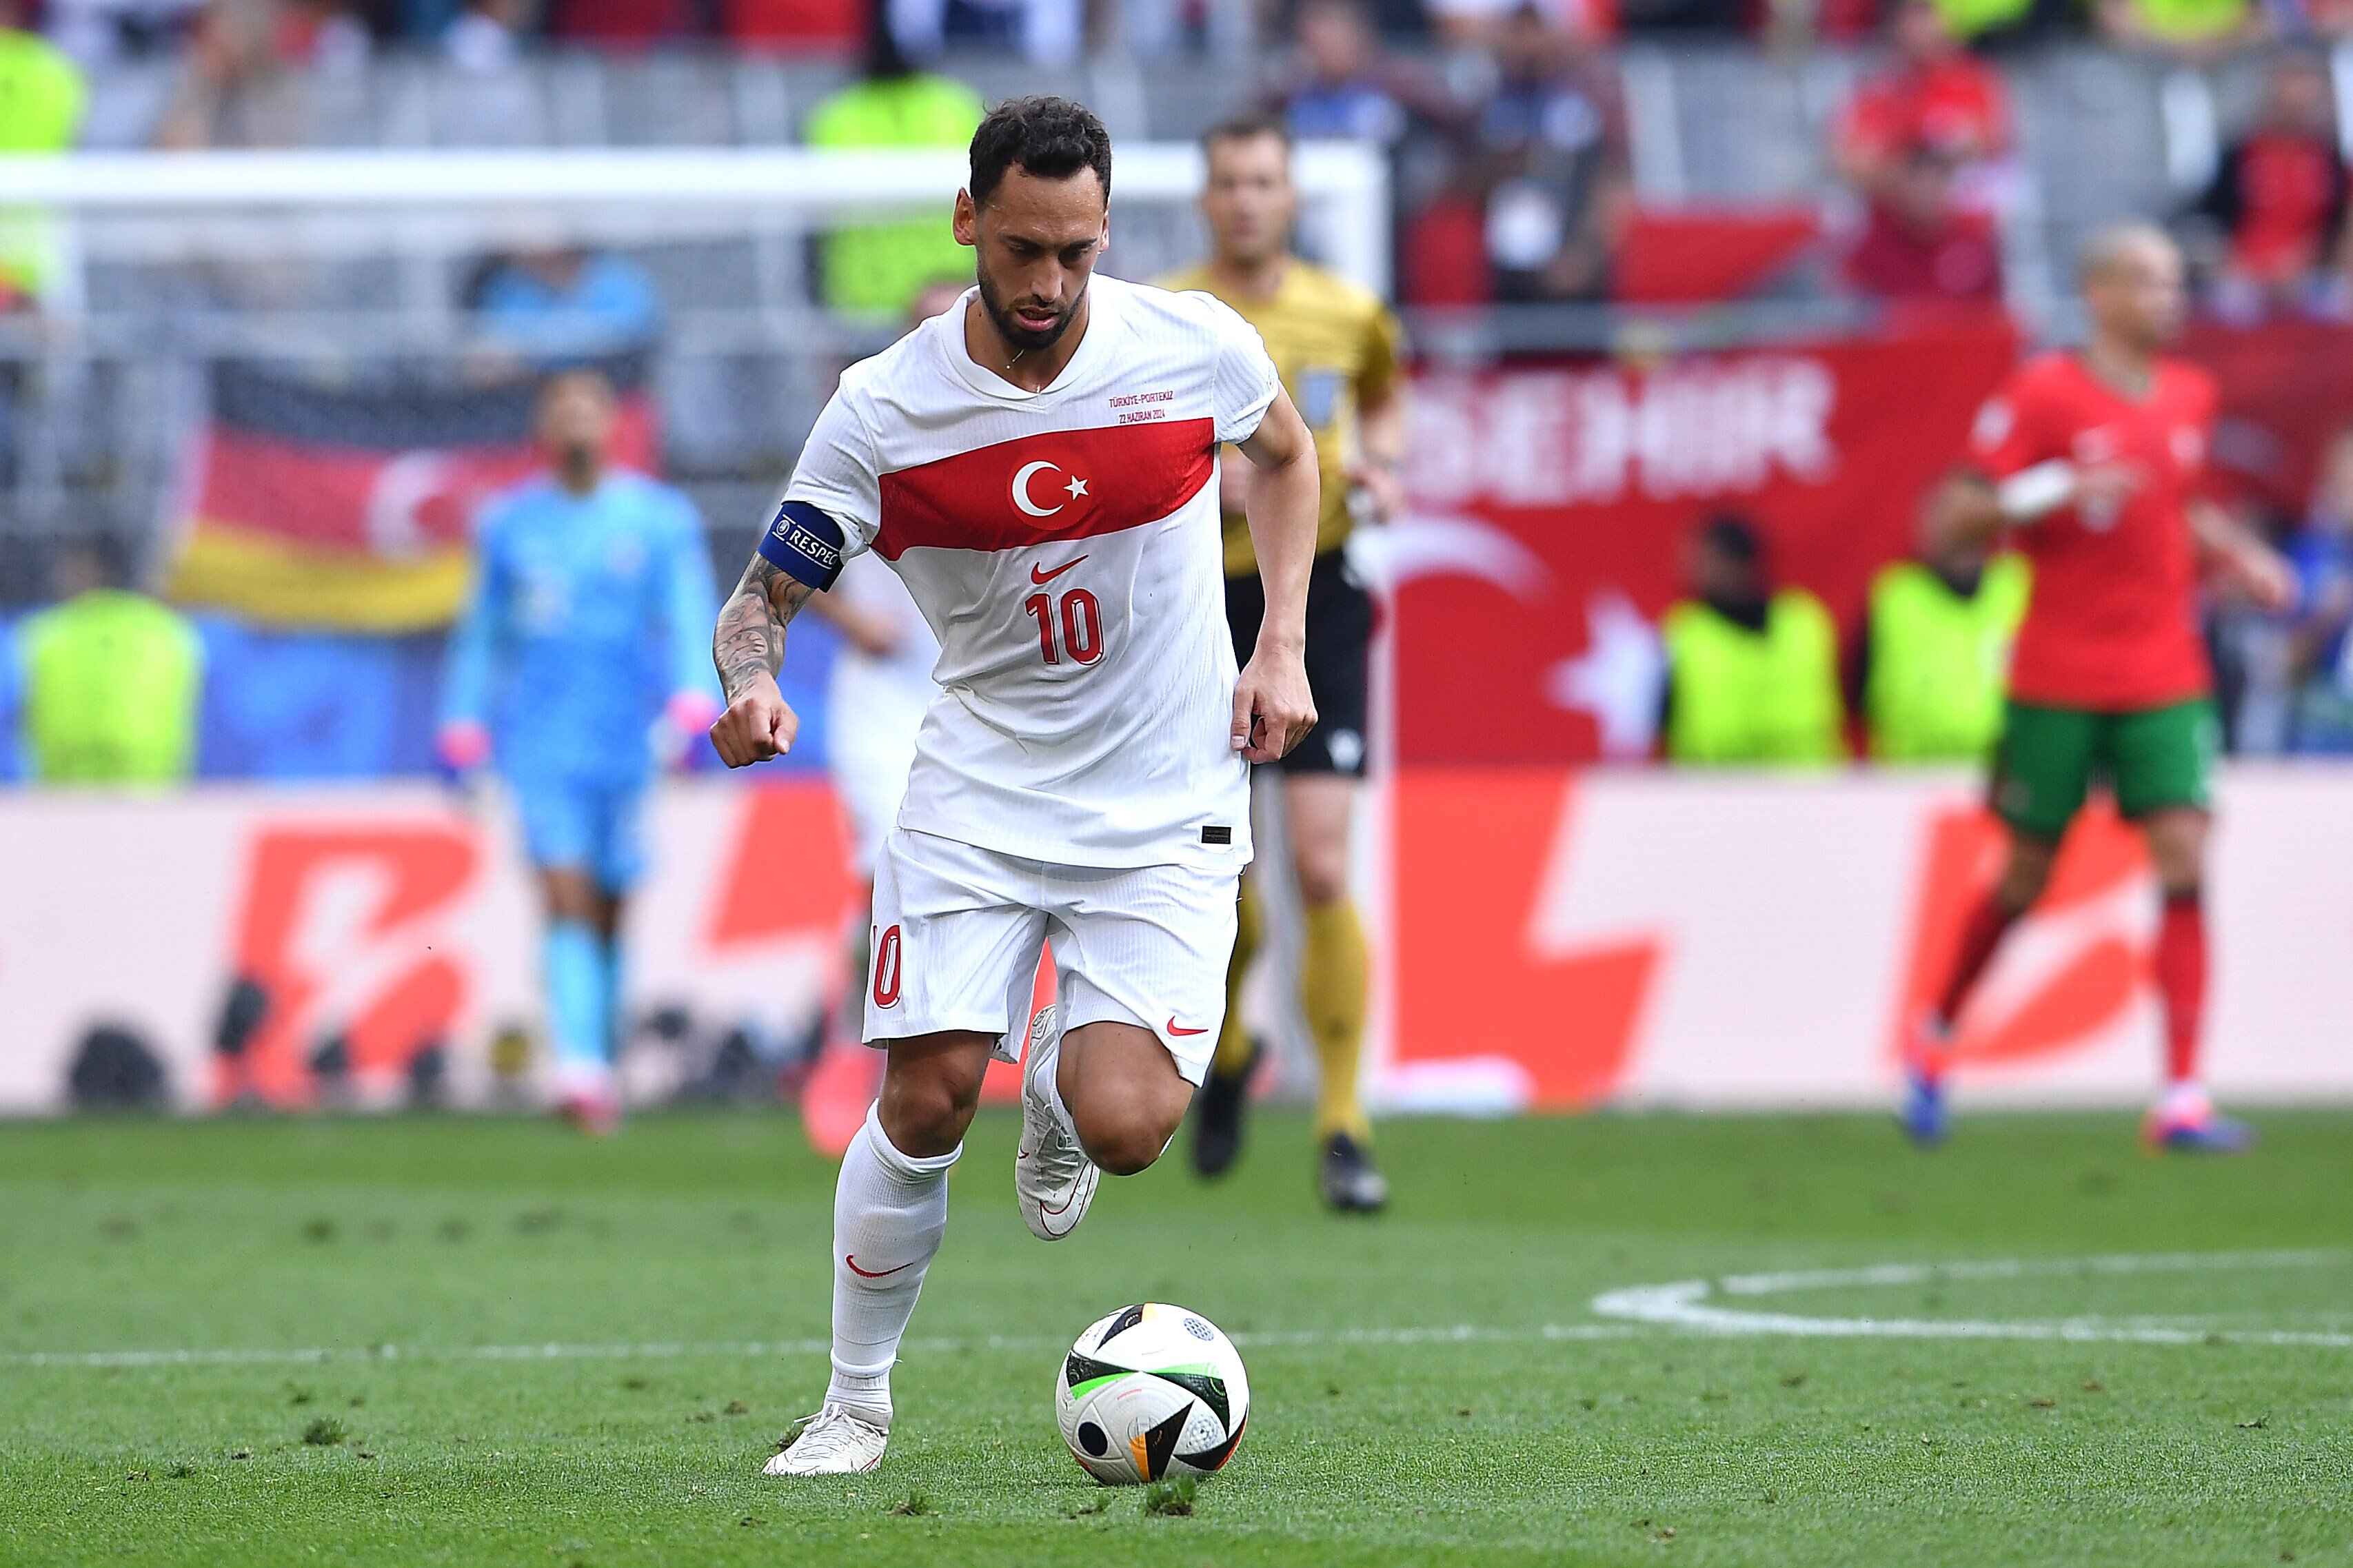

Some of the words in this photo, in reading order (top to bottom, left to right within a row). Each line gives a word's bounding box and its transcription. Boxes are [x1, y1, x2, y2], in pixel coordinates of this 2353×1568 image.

[1109, 389, 1174, 408] TÜRKİYE-PORTEKİZ
[1119, 414, 1126, 424] 22
[1127, 409, 1152, 422] HAZİRAN
[1152, 408, 1165, 420] 2024
[1024, 588, 1105, 666] 10
[872, 924, 901, 1010] 0
